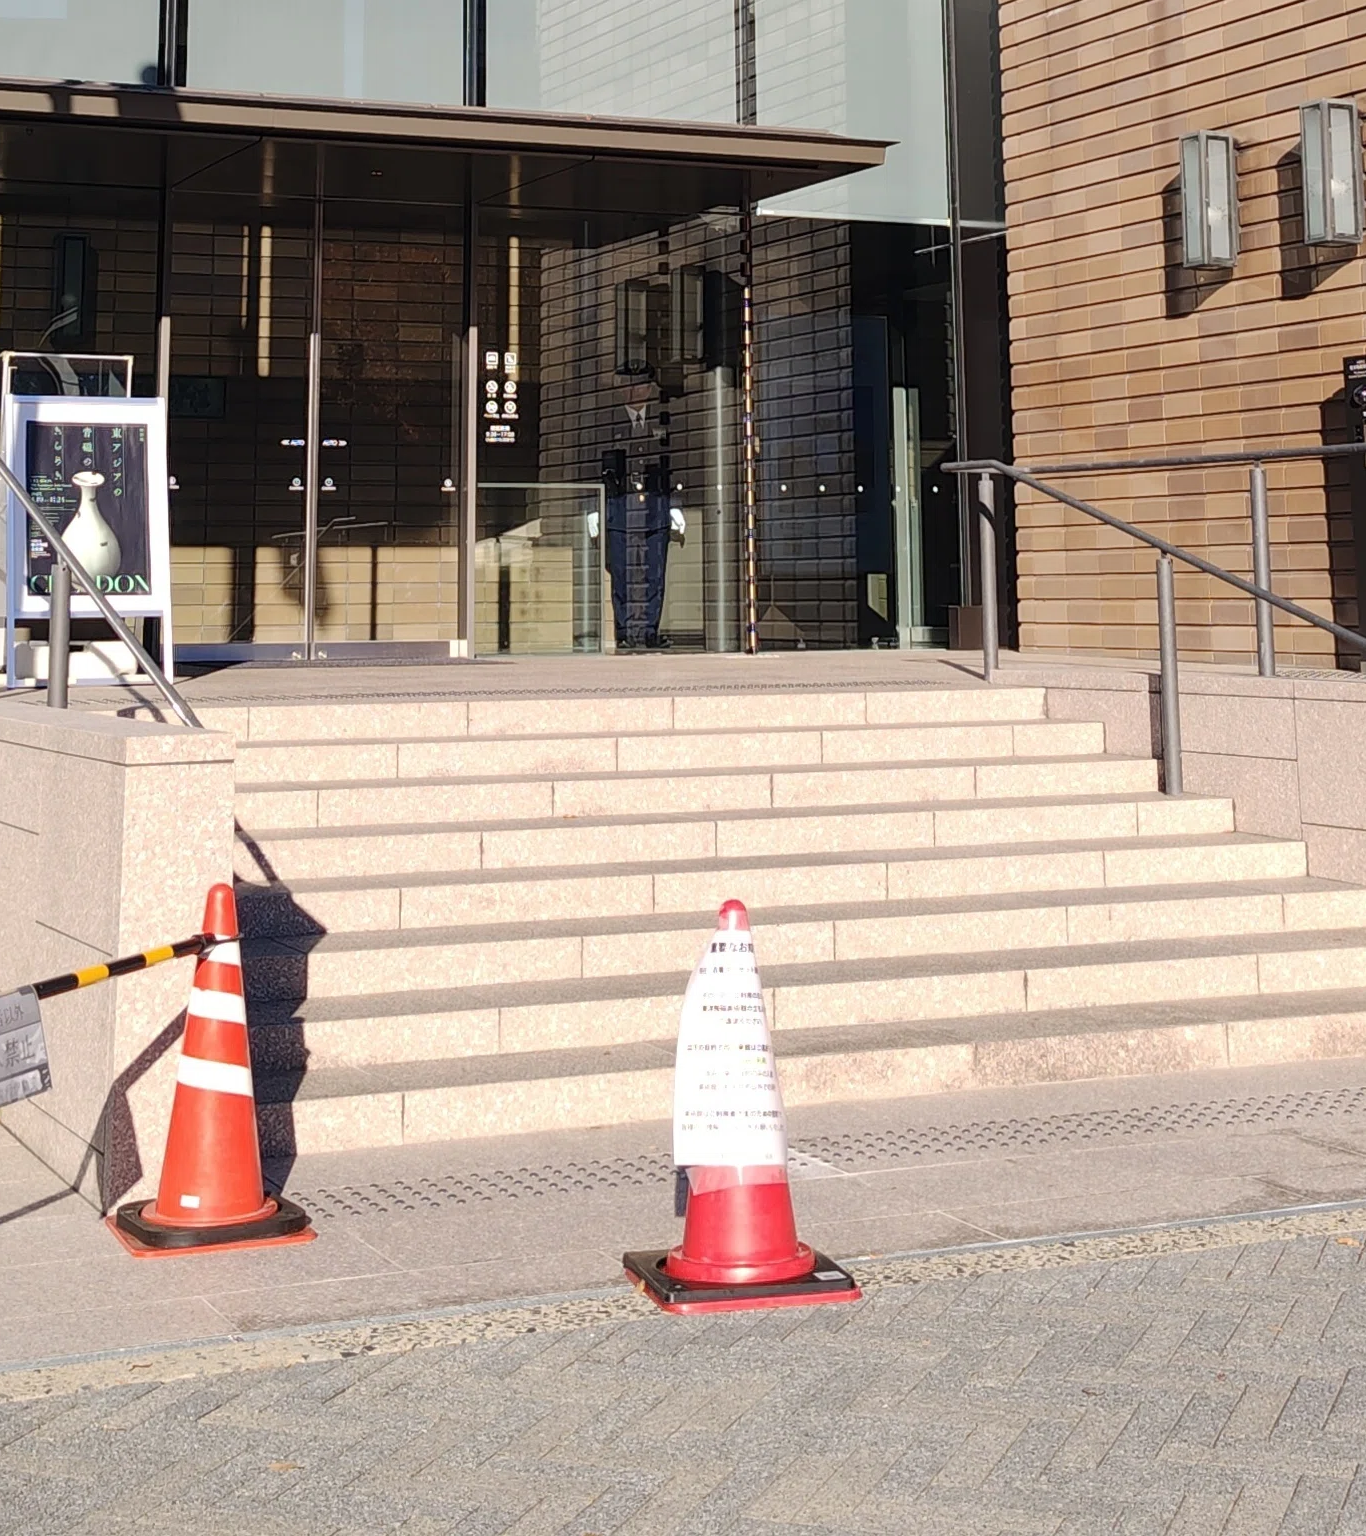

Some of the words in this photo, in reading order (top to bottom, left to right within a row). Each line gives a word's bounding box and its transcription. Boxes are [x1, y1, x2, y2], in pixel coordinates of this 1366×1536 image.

[110, 427, 123, 497] 東アジアの
[30, 574, 150, 593] CDON
